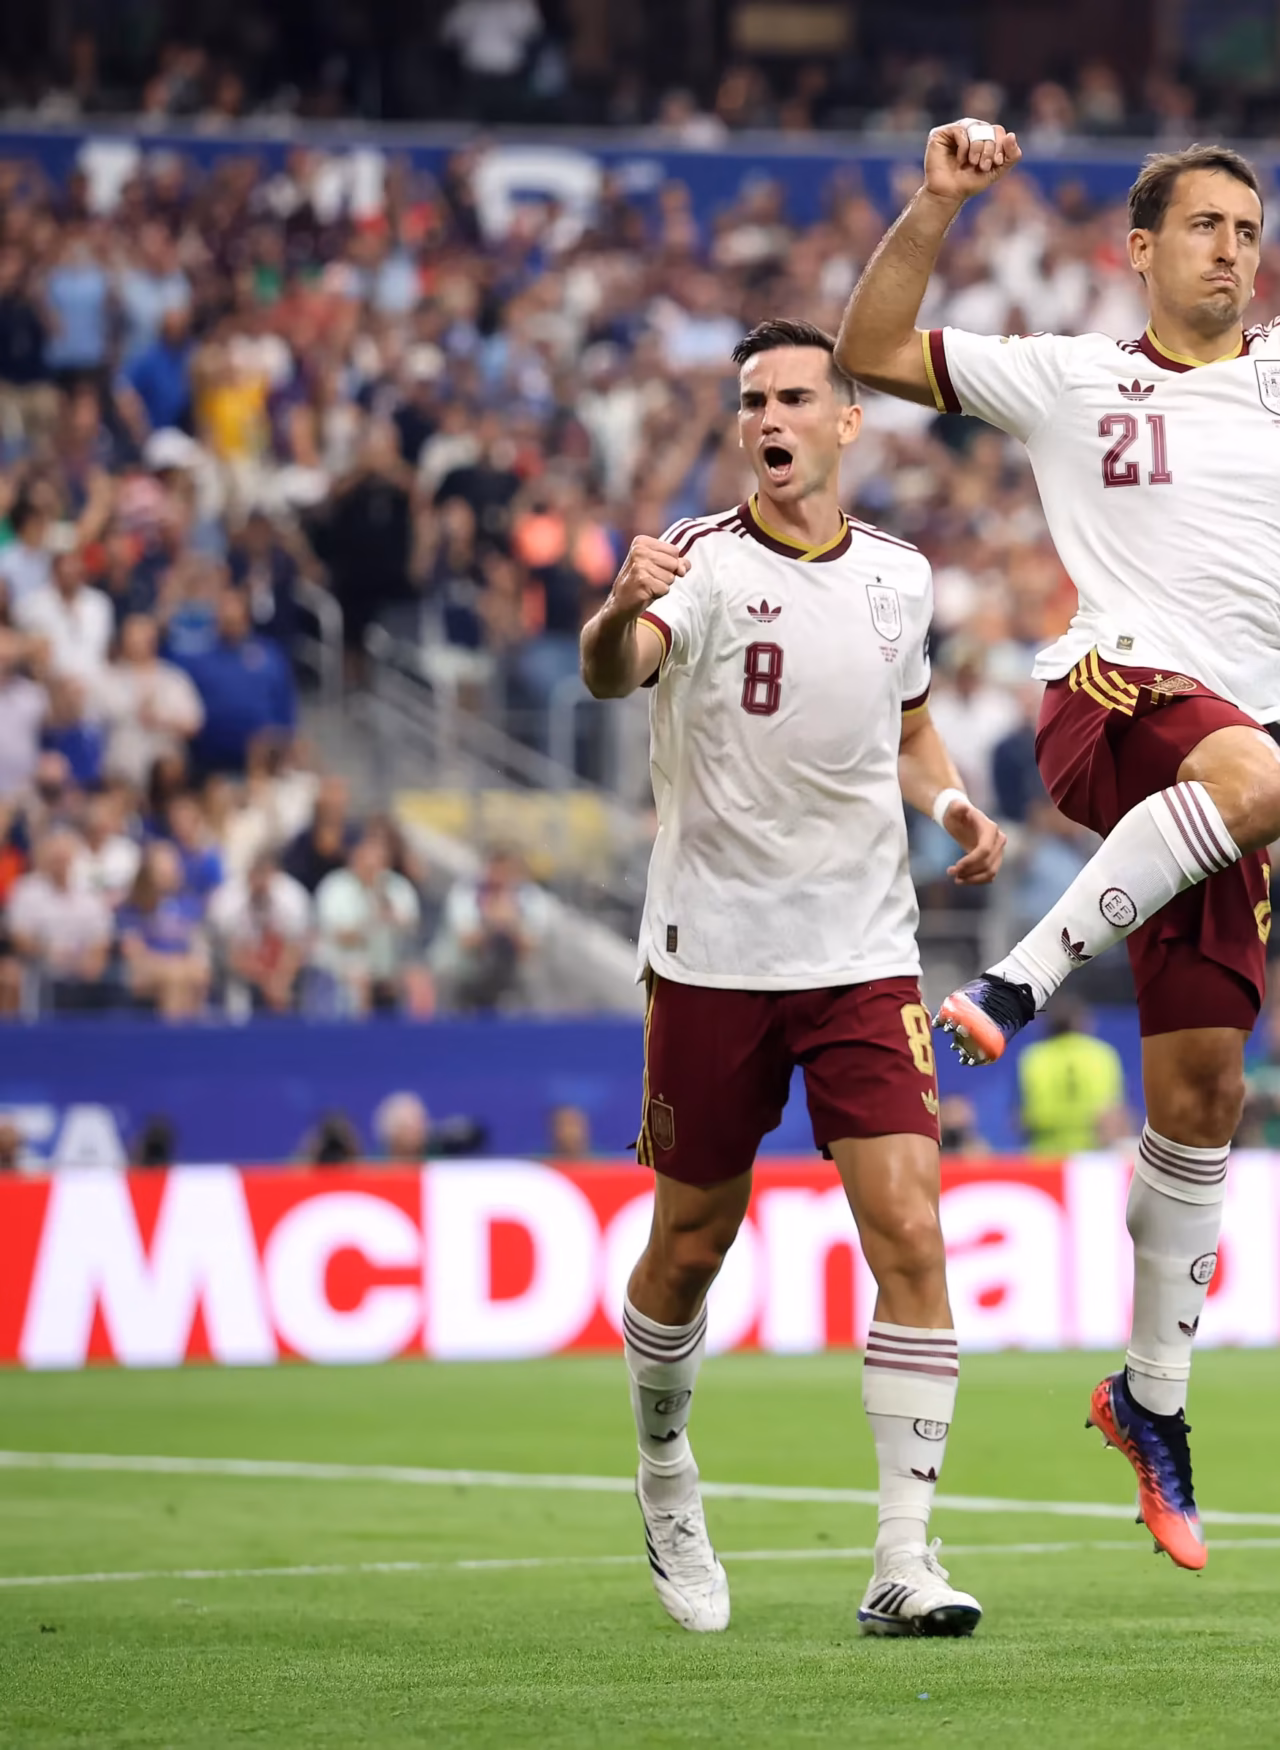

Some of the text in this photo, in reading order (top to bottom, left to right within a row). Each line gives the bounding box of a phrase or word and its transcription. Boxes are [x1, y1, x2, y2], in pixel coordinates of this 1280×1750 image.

[1098, 413, 1173, 488] 21
[740, 641, 784, 717] 8
[900, 1003, 935, 1077] 8
